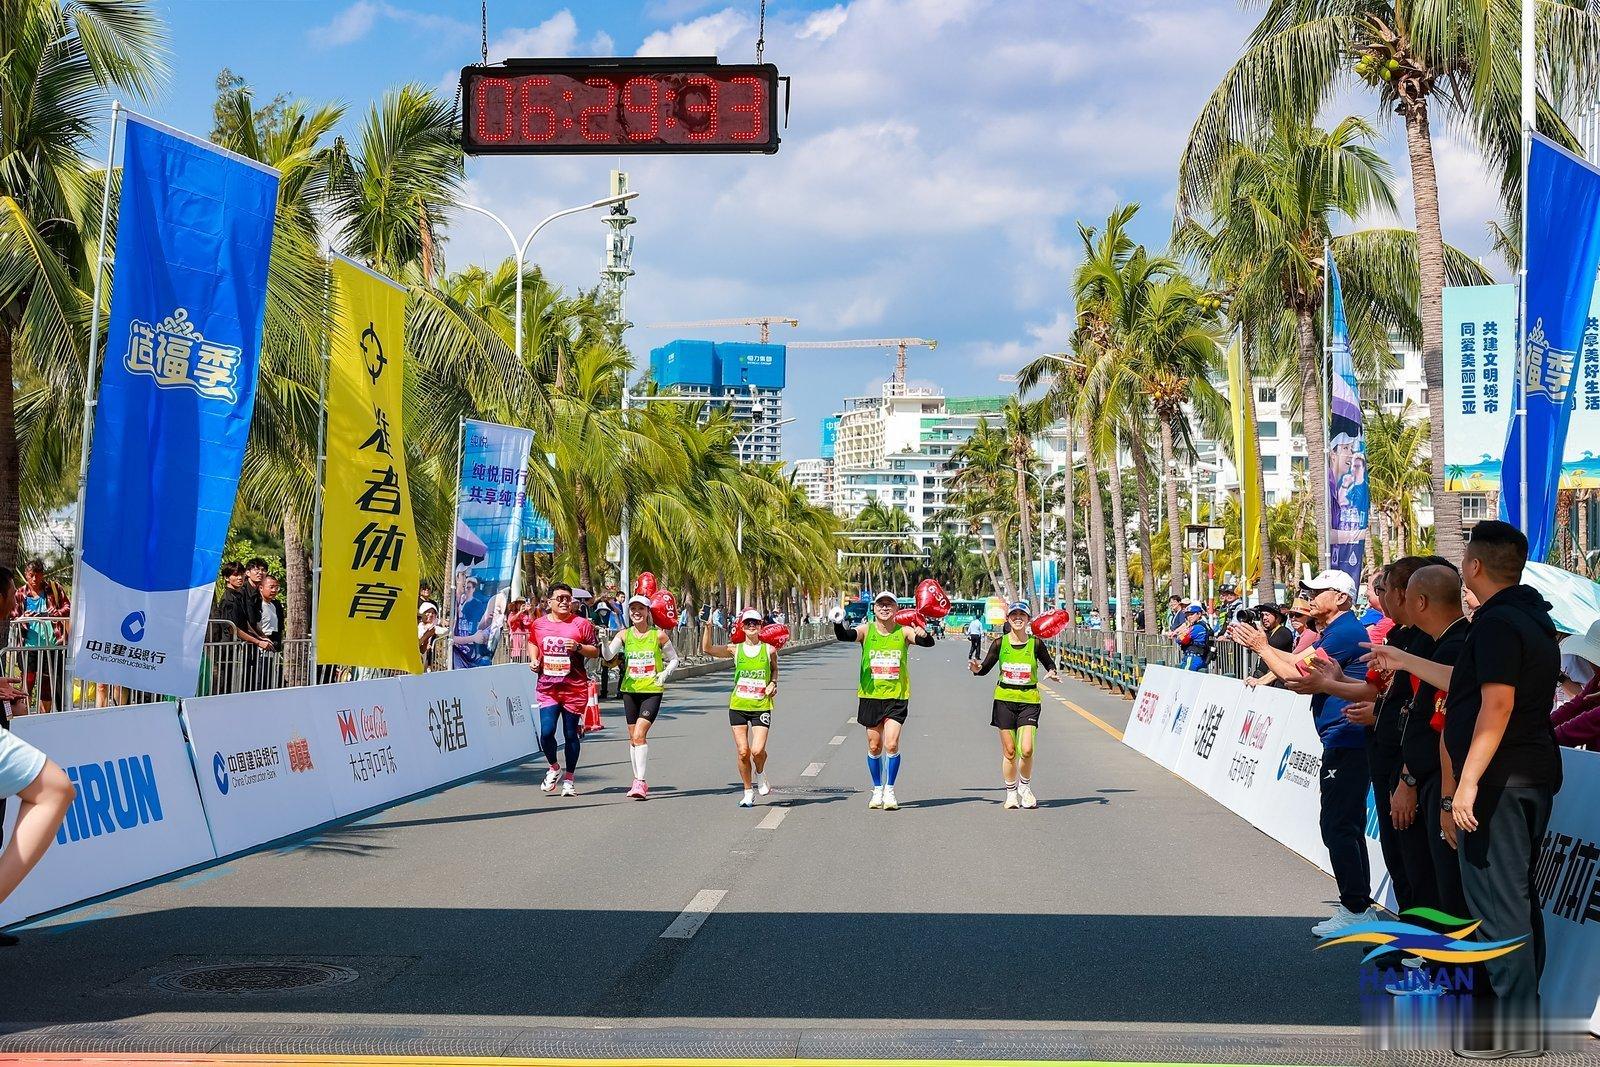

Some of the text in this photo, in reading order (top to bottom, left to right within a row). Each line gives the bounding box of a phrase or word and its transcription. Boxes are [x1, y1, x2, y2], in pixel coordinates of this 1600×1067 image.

[127, 322, 237, 399] 造福季
[1461, 322, 1476, 415] 同爱美丽三亚
[1483, 321, 1498, 413] 共建文明城市
[472, 463, 528, 485] 纯悦同行
[869, 649, 902, 659] PACER
[227, 746, 280, 774] 中国建设银行
[349, 746, 398, 782] 太古可口可乐
